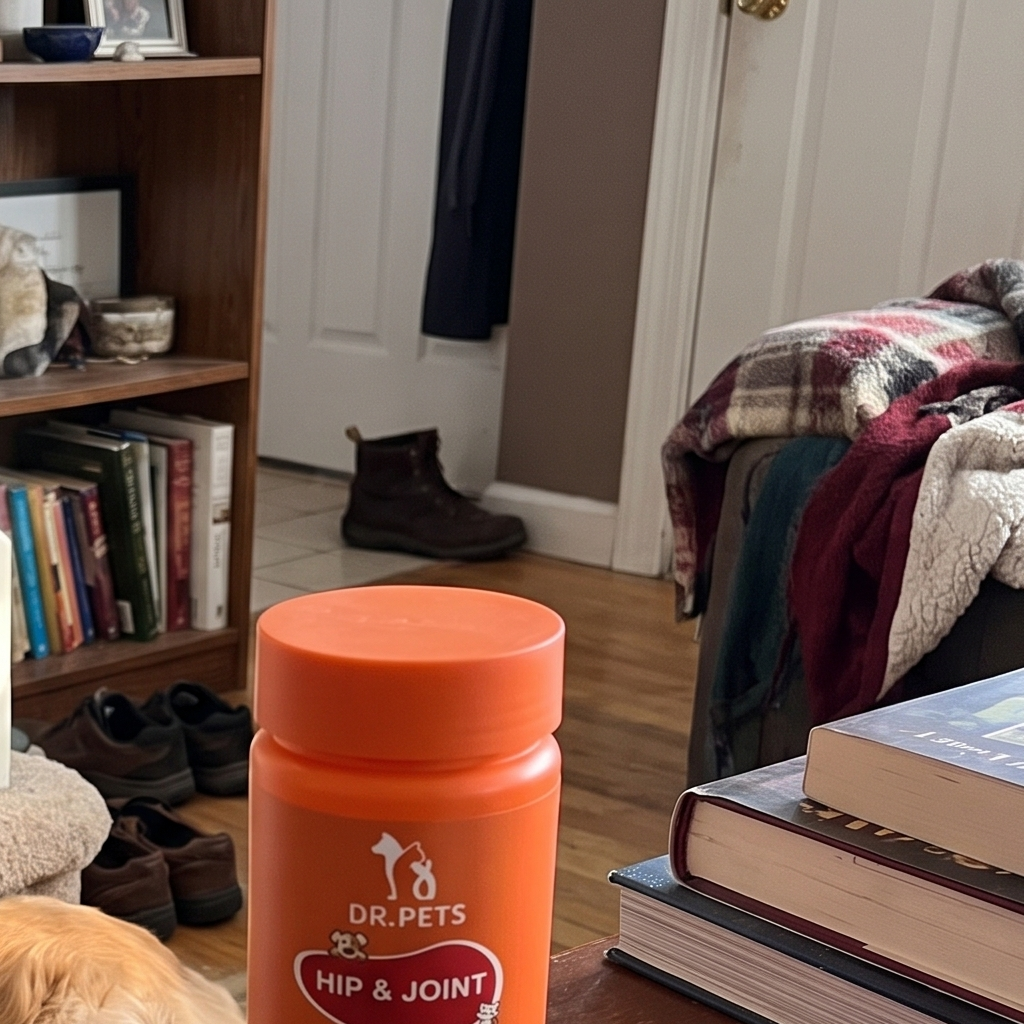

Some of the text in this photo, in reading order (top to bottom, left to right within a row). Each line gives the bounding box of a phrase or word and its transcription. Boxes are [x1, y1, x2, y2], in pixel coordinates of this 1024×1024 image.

[349, 903, 467, 928] DR.PETS
[316, 969, 488, 1002] HIP & JOINT
